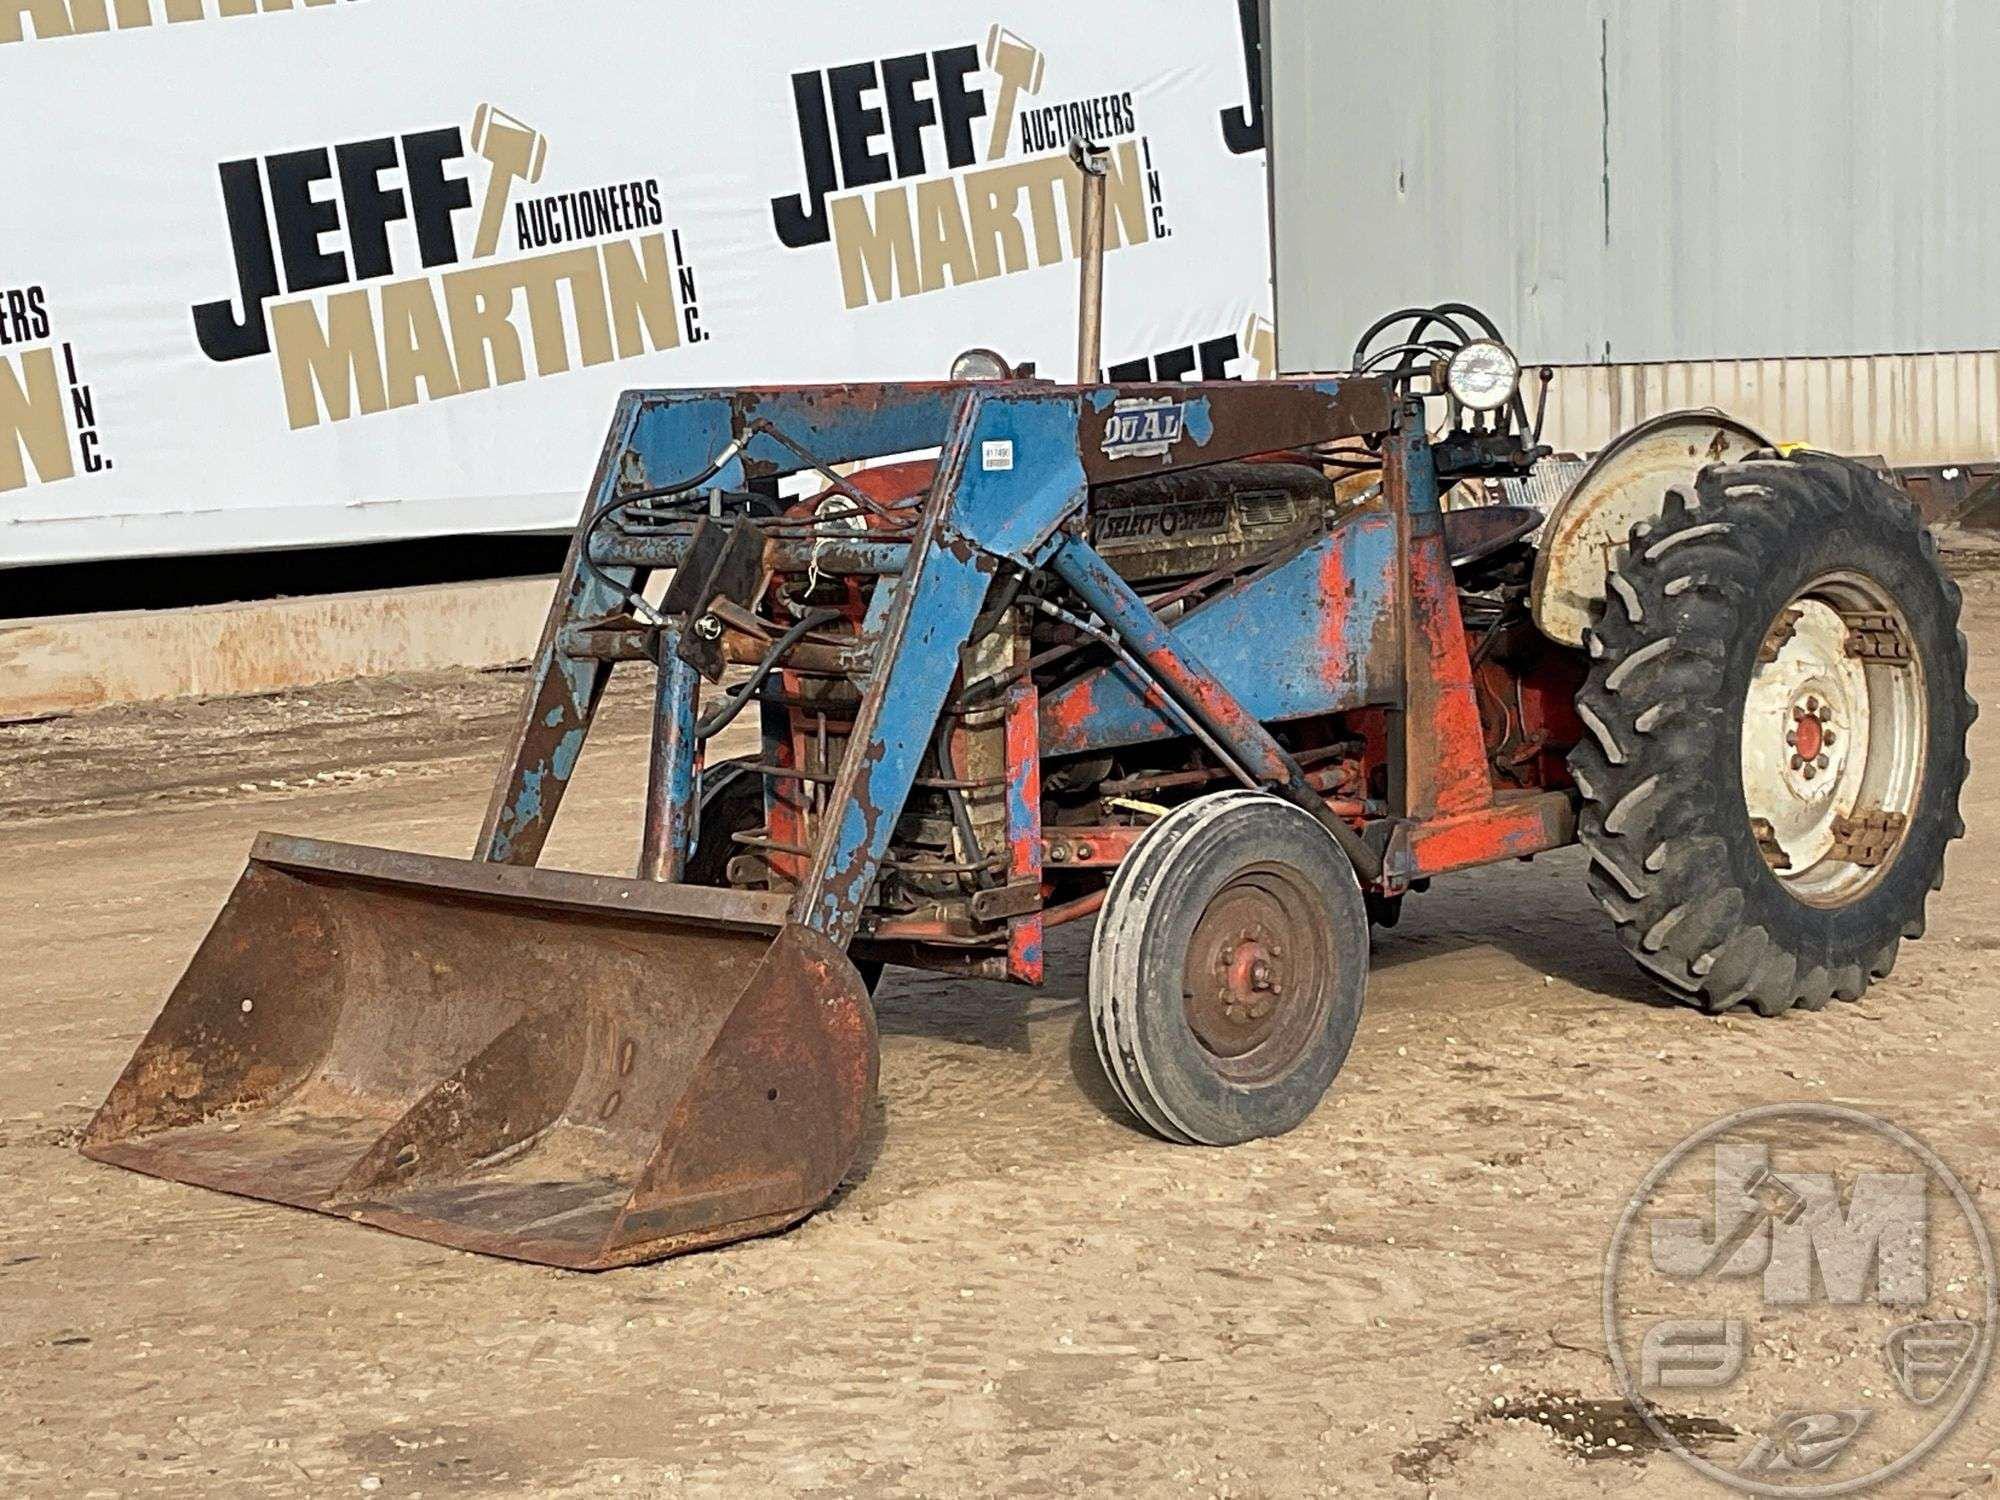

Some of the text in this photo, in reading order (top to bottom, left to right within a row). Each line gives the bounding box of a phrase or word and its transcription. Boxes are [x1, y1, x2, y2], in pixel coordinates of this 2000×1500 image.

[515, 179, 663, 250] AUCTIONEERS
[771, 45, 986, 249] JEFF
[1020, 92, 1135, 153] AUCTIONEERS
[191, 127, 472, 362] JEFF
[270, 233, 681, 430] MARTIN
